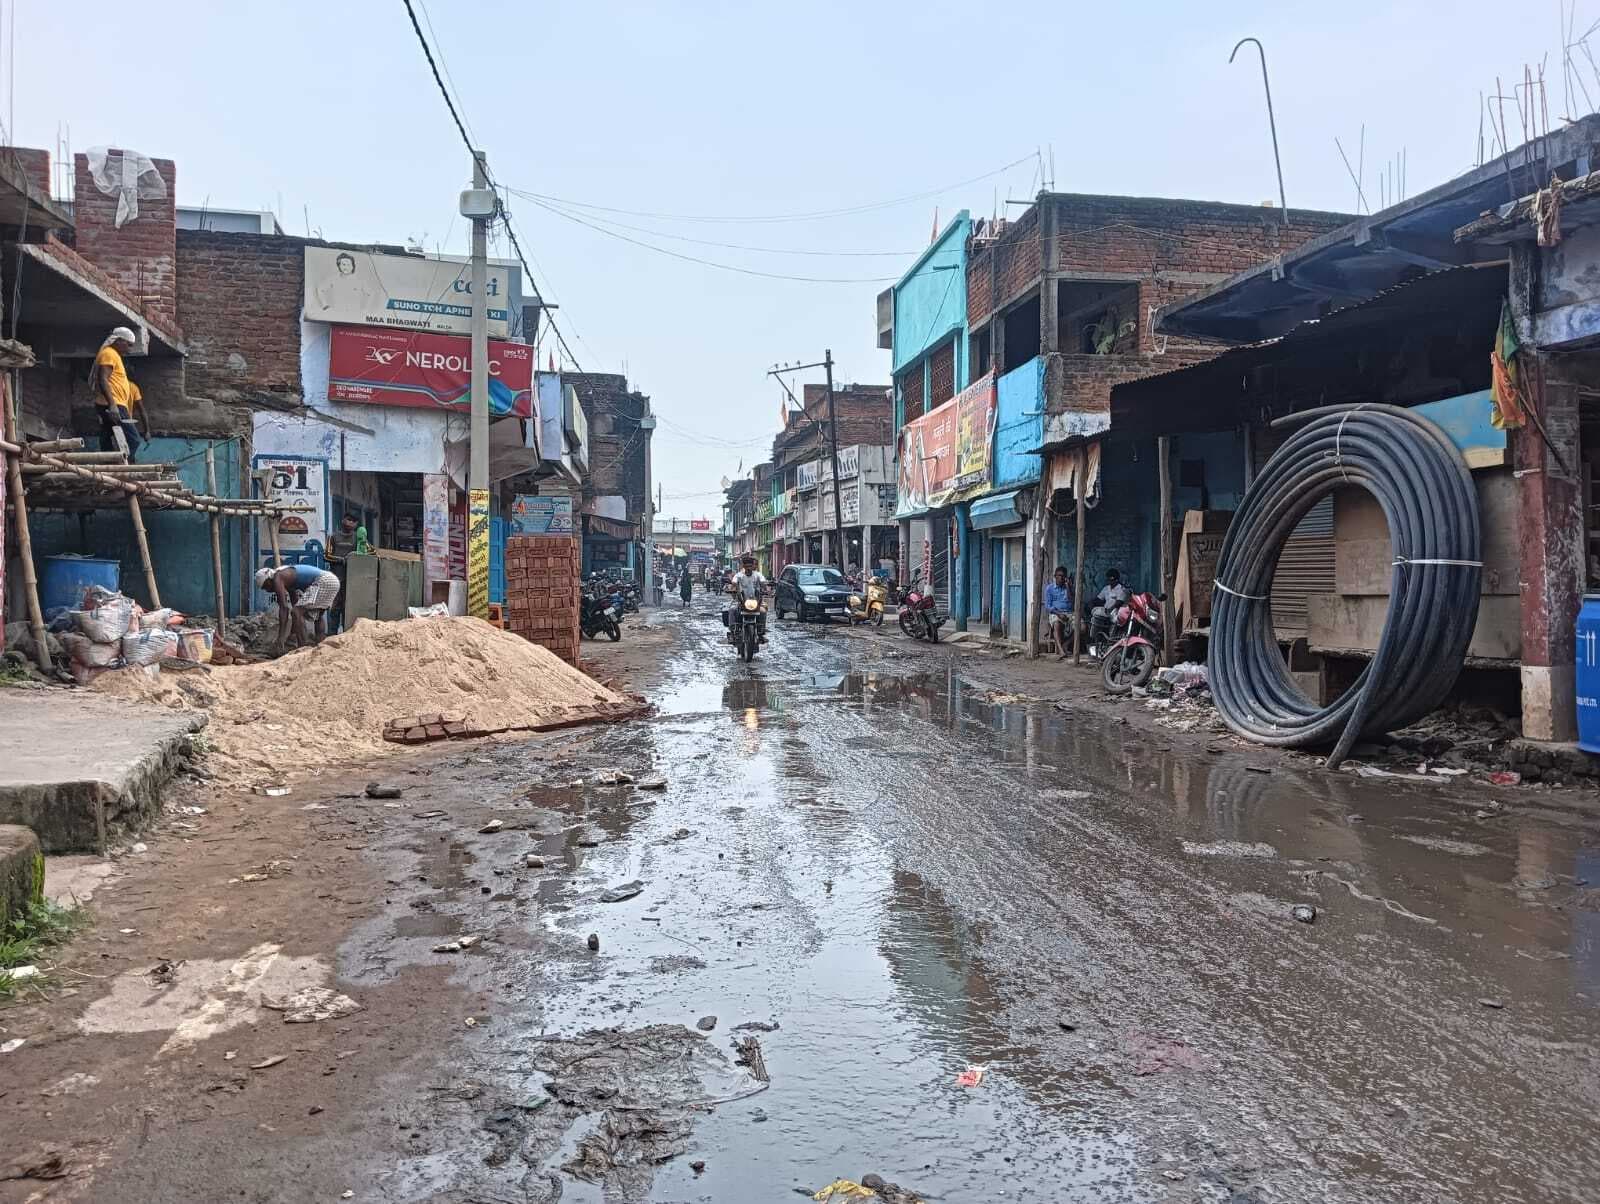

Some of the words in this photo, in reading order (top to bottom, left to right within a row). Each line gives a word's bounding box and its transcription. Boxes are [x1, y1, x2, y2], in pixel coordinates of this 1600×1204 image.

[394, 301, 420, 311] SUNO
[366, 316, 384, 324] MAA
[387, 318, 431, 328] BHAGWATI
[406, 351, 502, 376] NEROLC
